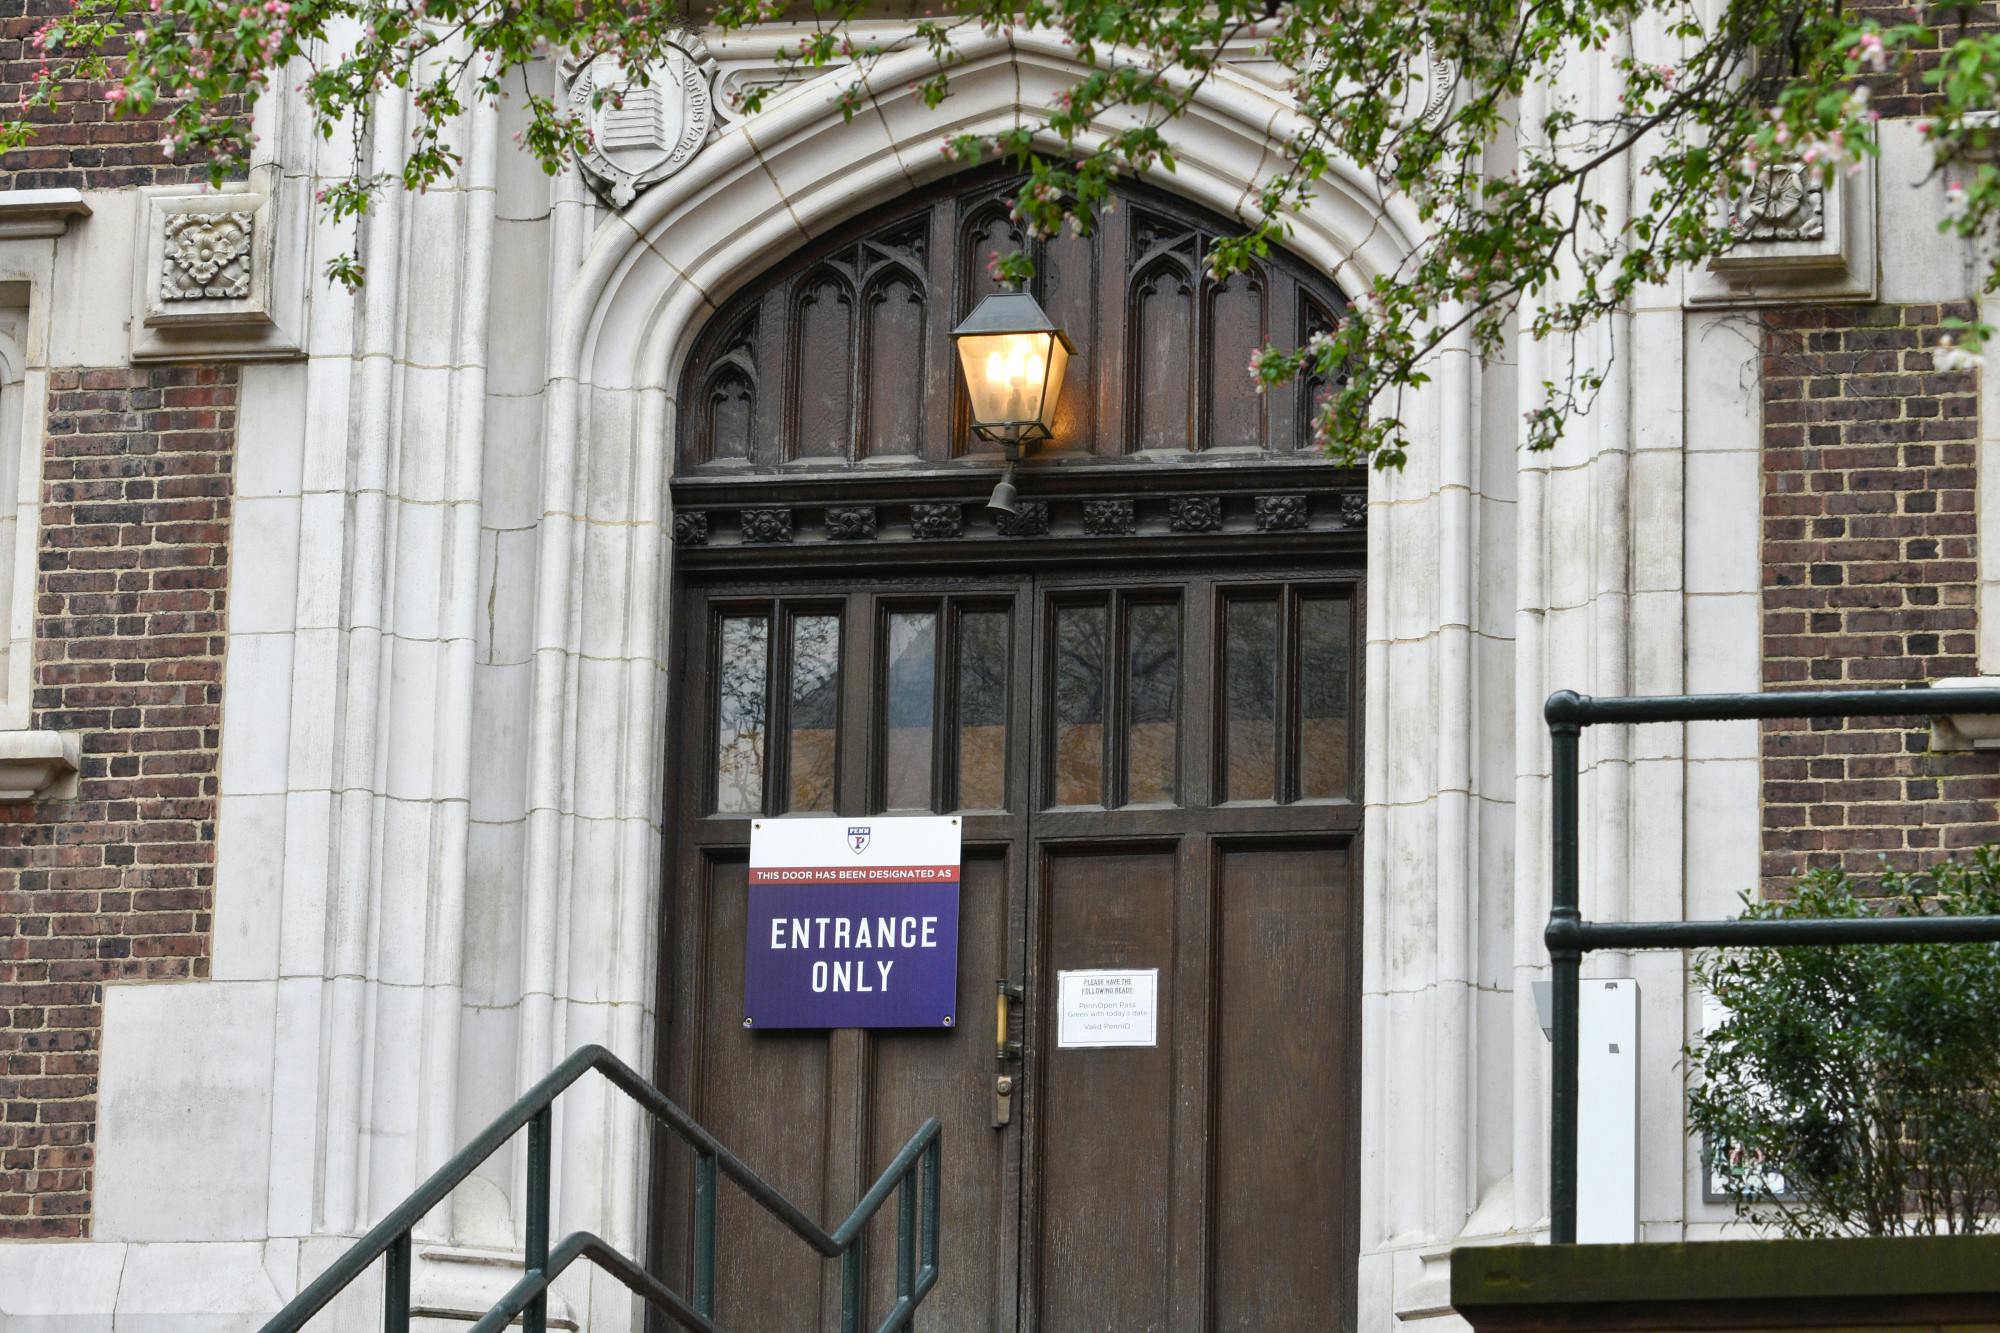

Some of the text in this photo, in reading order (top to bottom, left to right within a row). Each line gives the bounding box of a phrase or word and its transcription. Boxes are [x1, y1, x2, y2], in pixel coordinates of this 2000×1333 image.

[854, 836, 865, 849] P
[757, 869, 952, 880] THIS DOOR HAS BEEN DESIGNATED AS
[771, 917, 938, 949] ENTRANCE
[812, 961, 894, 992] ONLY
[1090, 1009, 1104, 1017] with
[1106, 1009, 1130, 1017] today's
[1084, 1022, 1131, 1031] Valid PennID
